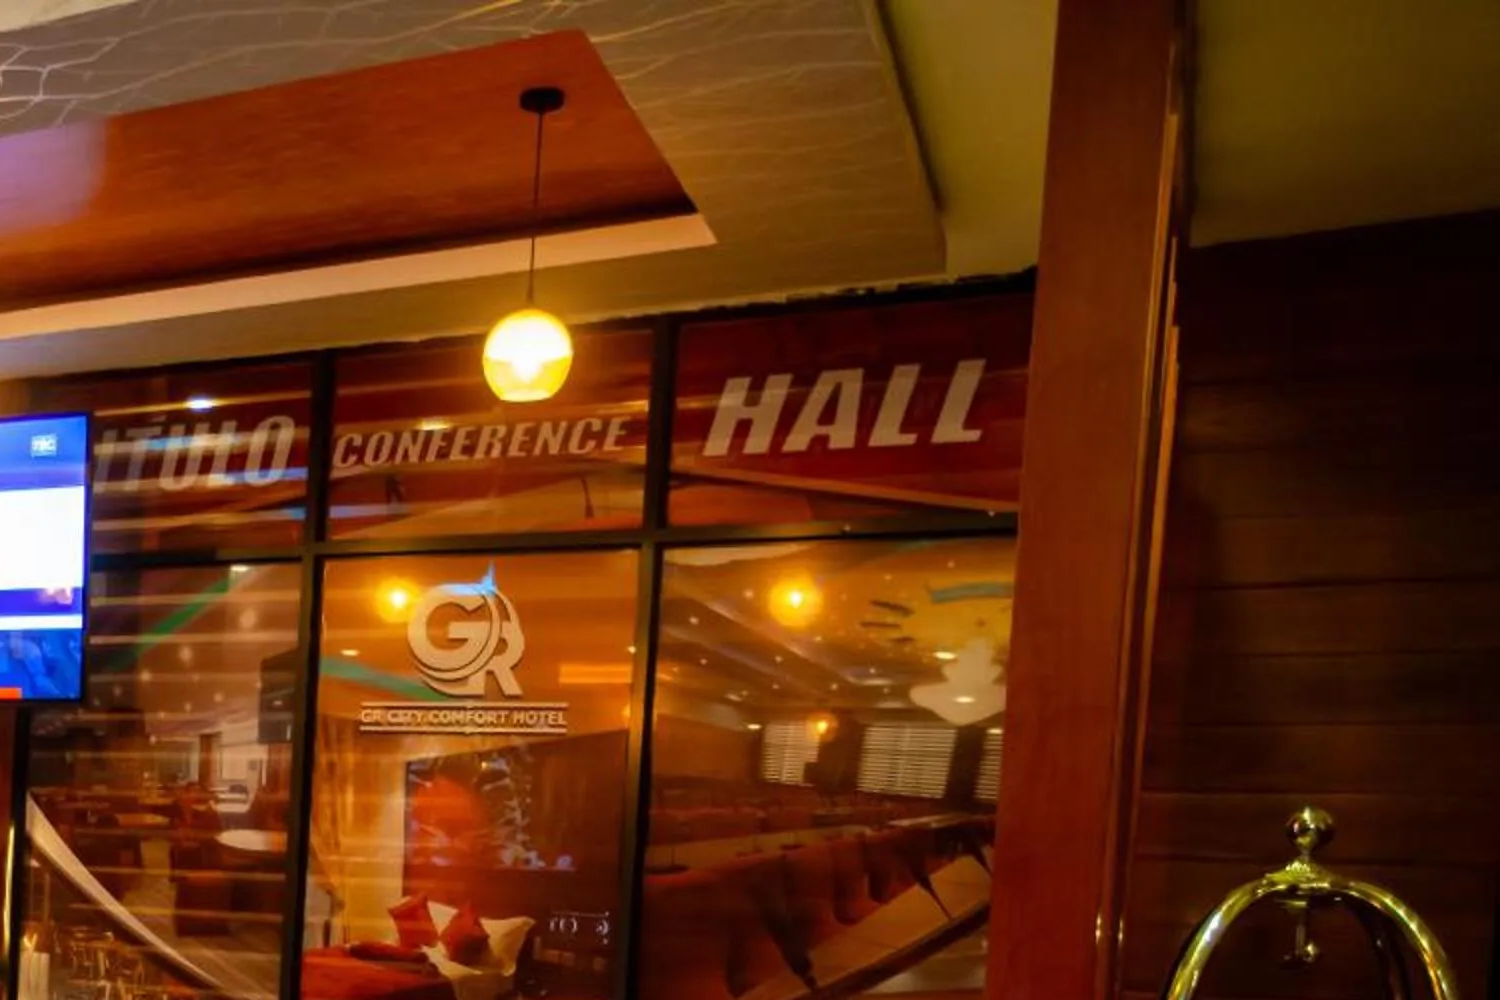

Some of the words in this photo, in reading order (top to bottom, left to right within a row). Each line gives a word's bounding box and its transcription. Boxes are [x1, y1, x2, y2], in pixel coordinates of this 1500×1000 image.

[93, 415, 296, 493] ITULO
[332, 416, 630, 470] CONFERENCE
[703, 359, 986, 457] HALL
[407, 583, 526, 696] GR
[428, 710, 510, 725] COMFORT
[513, 711, 568, 726] HOTEL
